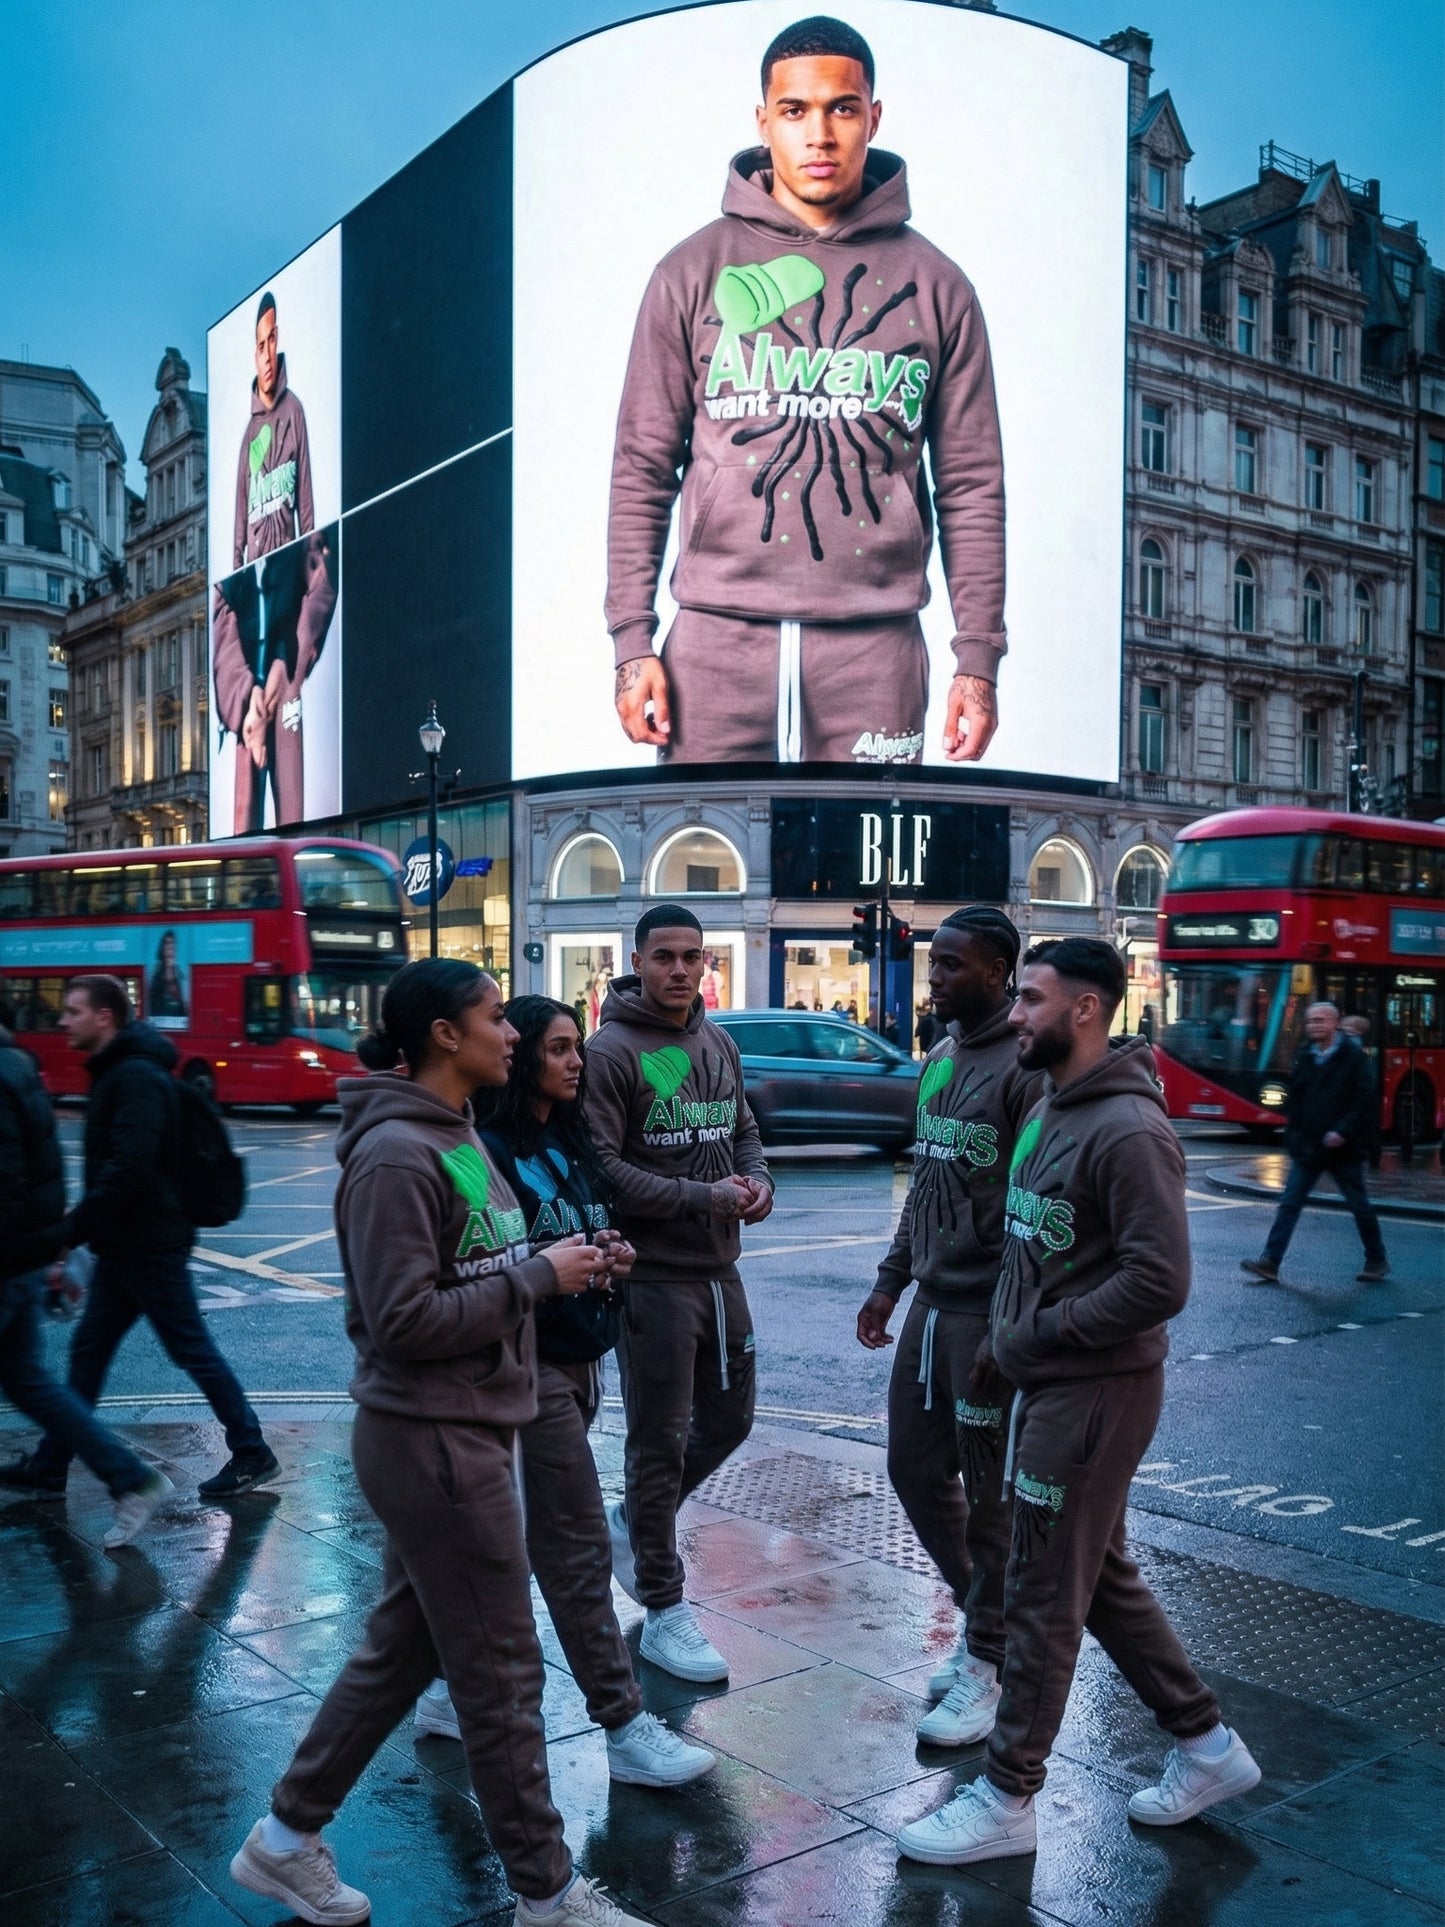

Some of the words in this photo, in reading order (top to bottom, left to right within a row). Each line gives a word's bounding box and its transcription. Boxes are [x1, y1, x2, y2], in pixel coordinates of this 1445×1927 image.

[705, 332, 931, 424] Always
[704, 389, 771, 421] want
[777, 393, 863, 420] more
[859, 813, 931, 886] BLF
[643, 1127, 693, 1146] want
[698, 1127, 730, 1142] more
